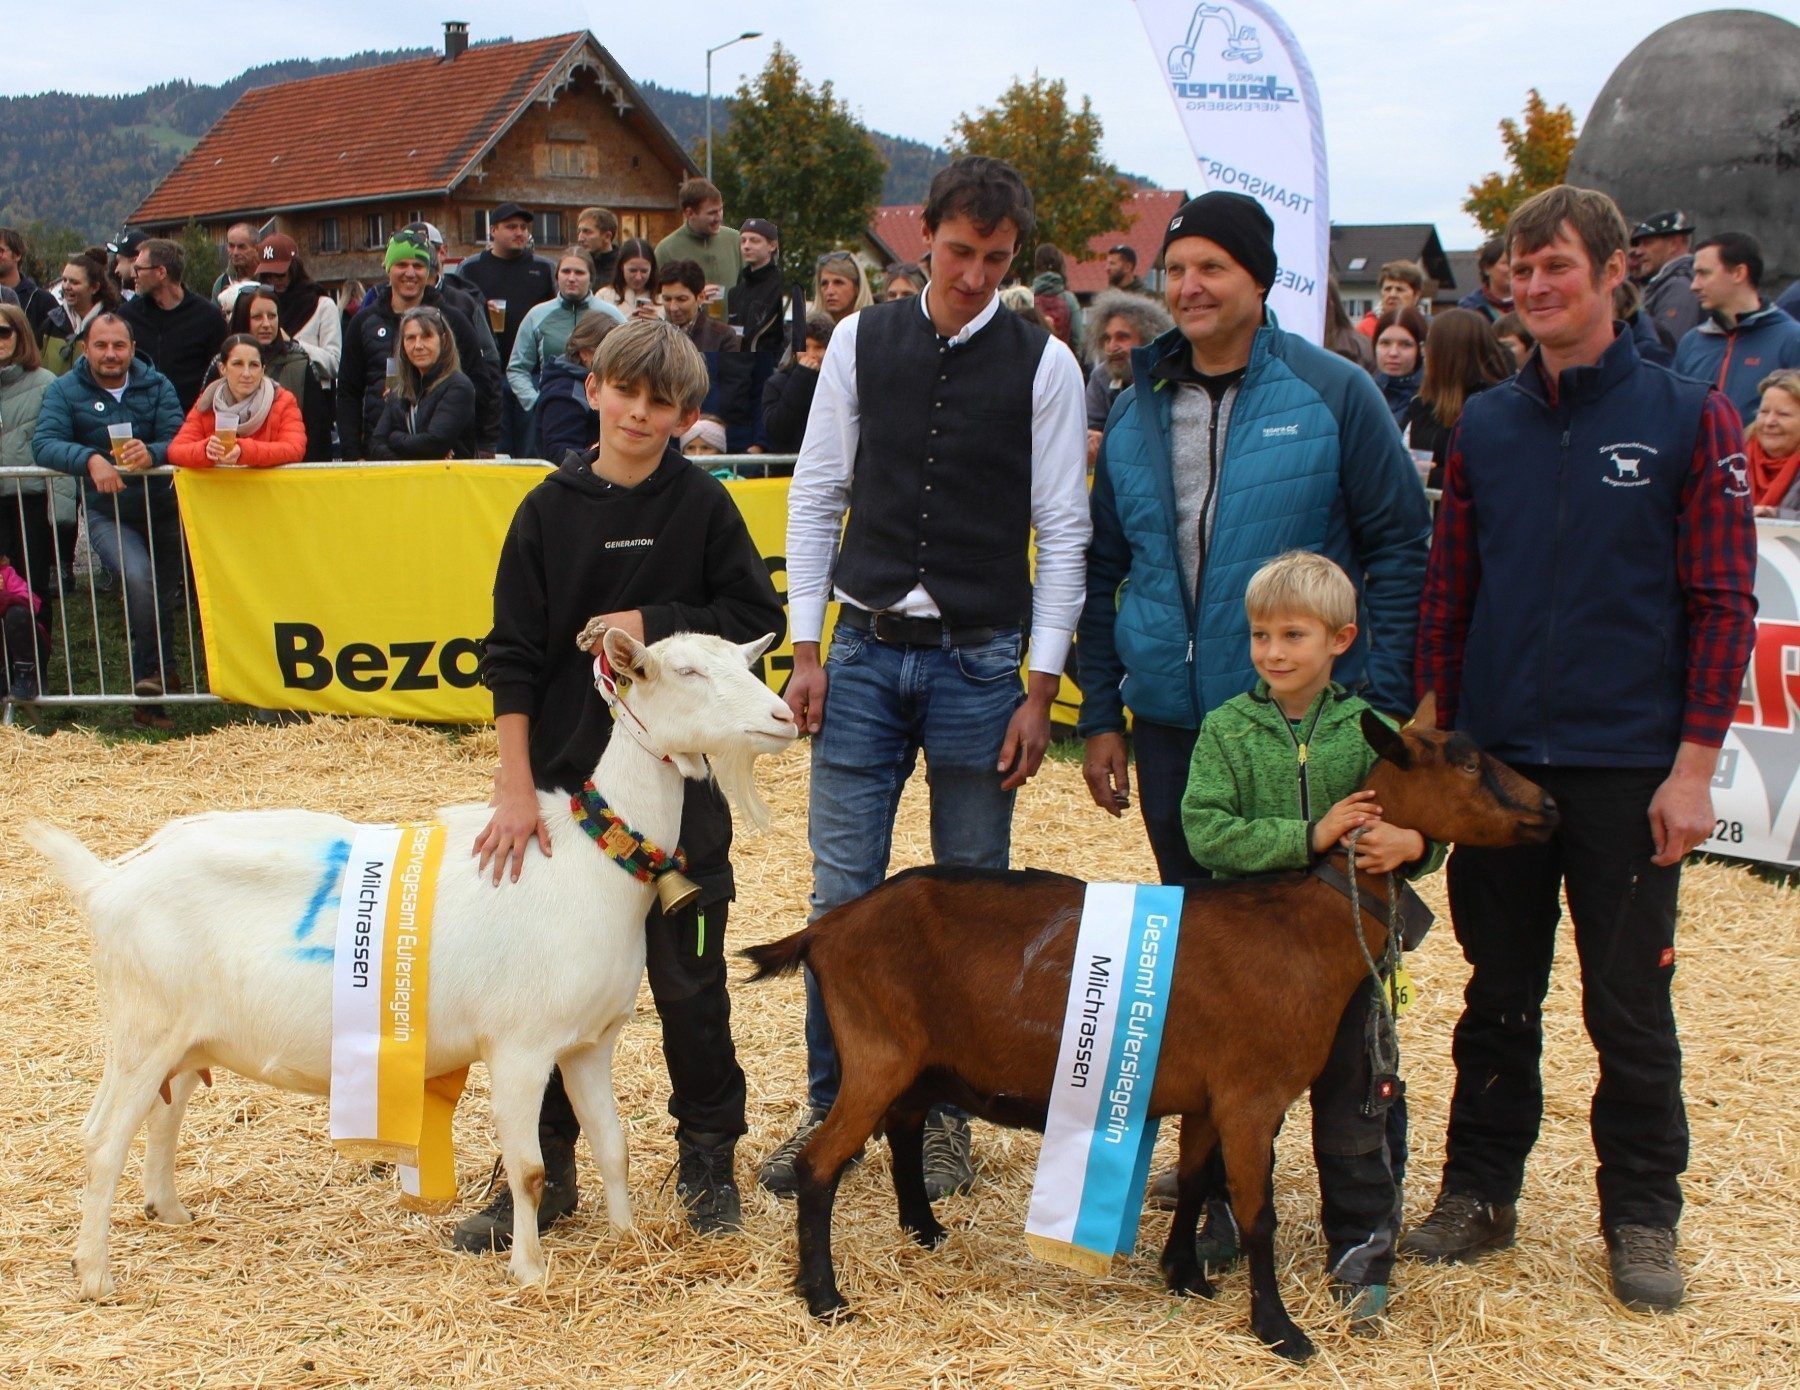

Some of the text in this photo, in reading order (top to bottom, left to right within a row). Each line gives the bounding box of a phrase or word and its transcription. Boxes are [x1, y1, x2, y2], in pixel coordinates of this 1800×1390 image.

[604, 538, 654, 549] GENERATION
[1708, 819, 1743, 843] 28
[352, 861, 384, 988] Milchrassen
[389, 934, 418, 1042] Eutersiegerin
[1070, 954, 1112, 1089] Milchrassen
[1105, 914, 1168, 1144] Gesamt Eutersiegerin
